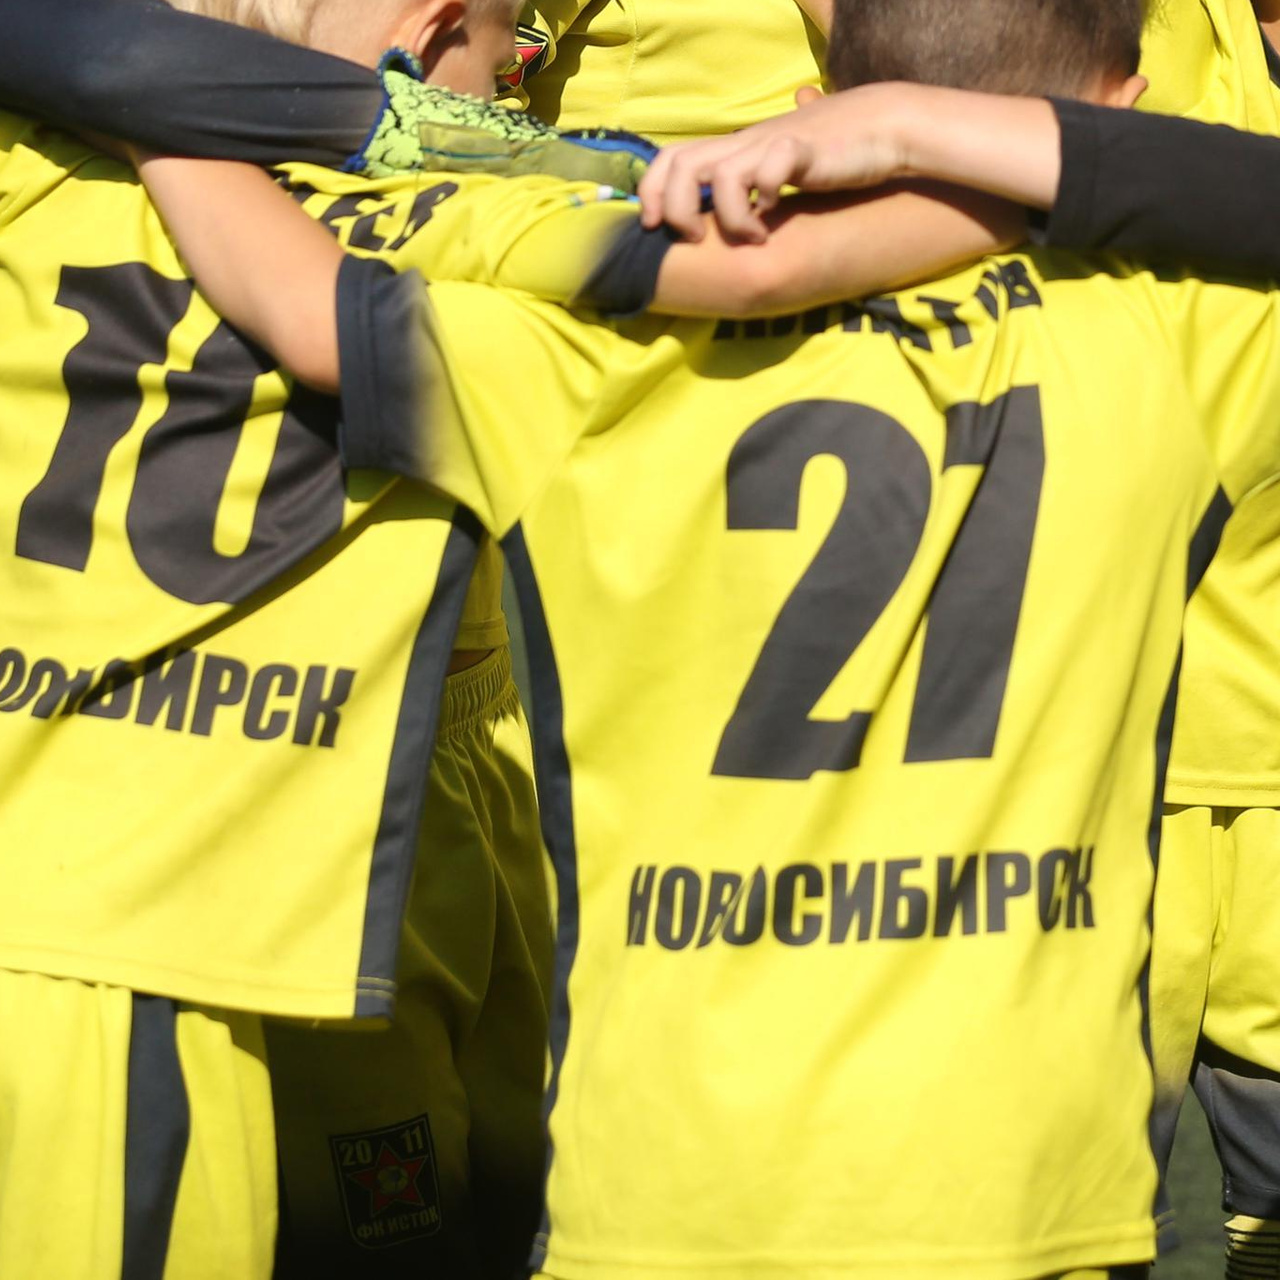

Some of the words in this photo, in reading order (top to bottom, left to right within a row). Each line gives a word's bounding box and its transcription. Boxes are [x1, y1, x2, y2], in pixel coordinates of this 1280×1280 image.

[15, 261, 345, 607] 10
[710, 384, 1046, 781] 21
[626, 845, 1096, 951] НОВОСИБИРСК
[338, 1139, 373, 1167] 20
[400, 1125, 424, 1153] 11
[356, 1219, 385, 1240] ФК
[388, 1204, 439, 1233] ИСТОК
